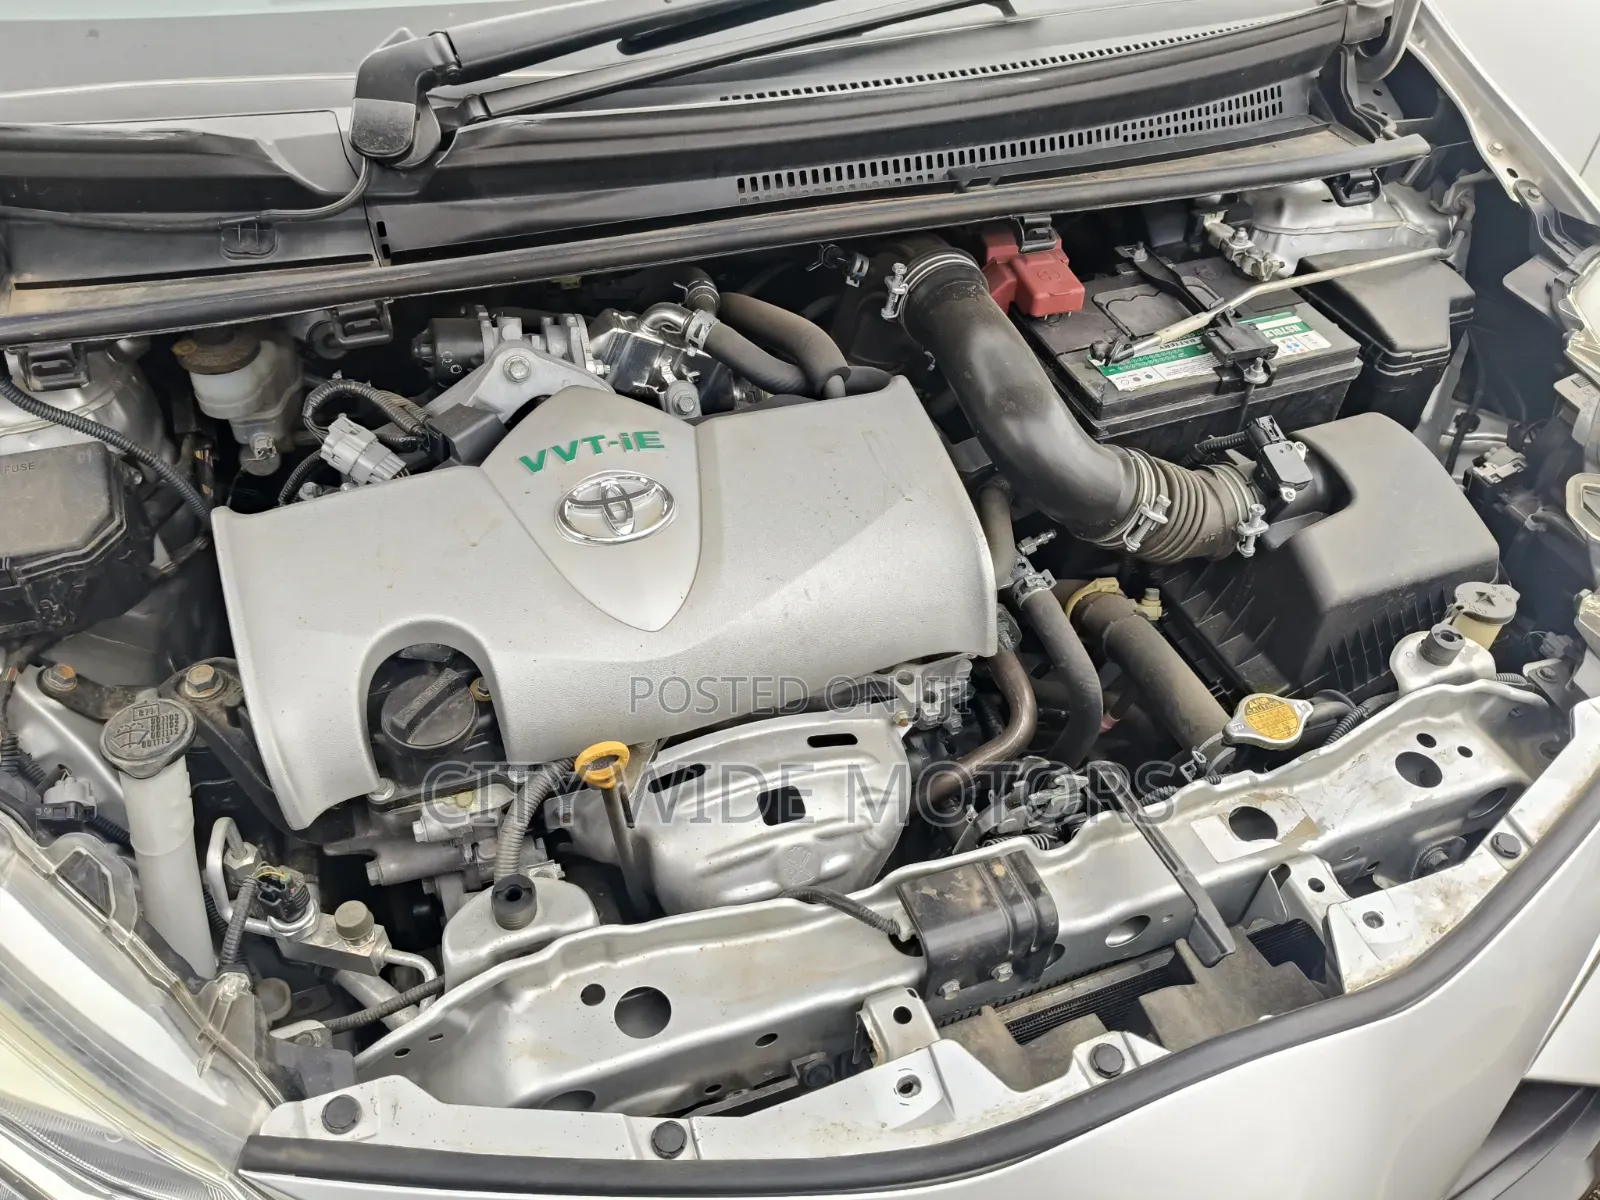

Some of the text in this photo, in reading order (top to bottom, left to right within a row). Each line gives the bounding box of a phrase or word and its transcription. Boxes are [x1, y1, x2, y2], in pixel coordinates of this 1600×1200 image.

[519, 430, 665, 475] VVT-iE
[4, 461, 37, 474] FUSE
[427, 670, 454, 694] ENGINE
[1246, 701, 1280, 715] CAUTION
